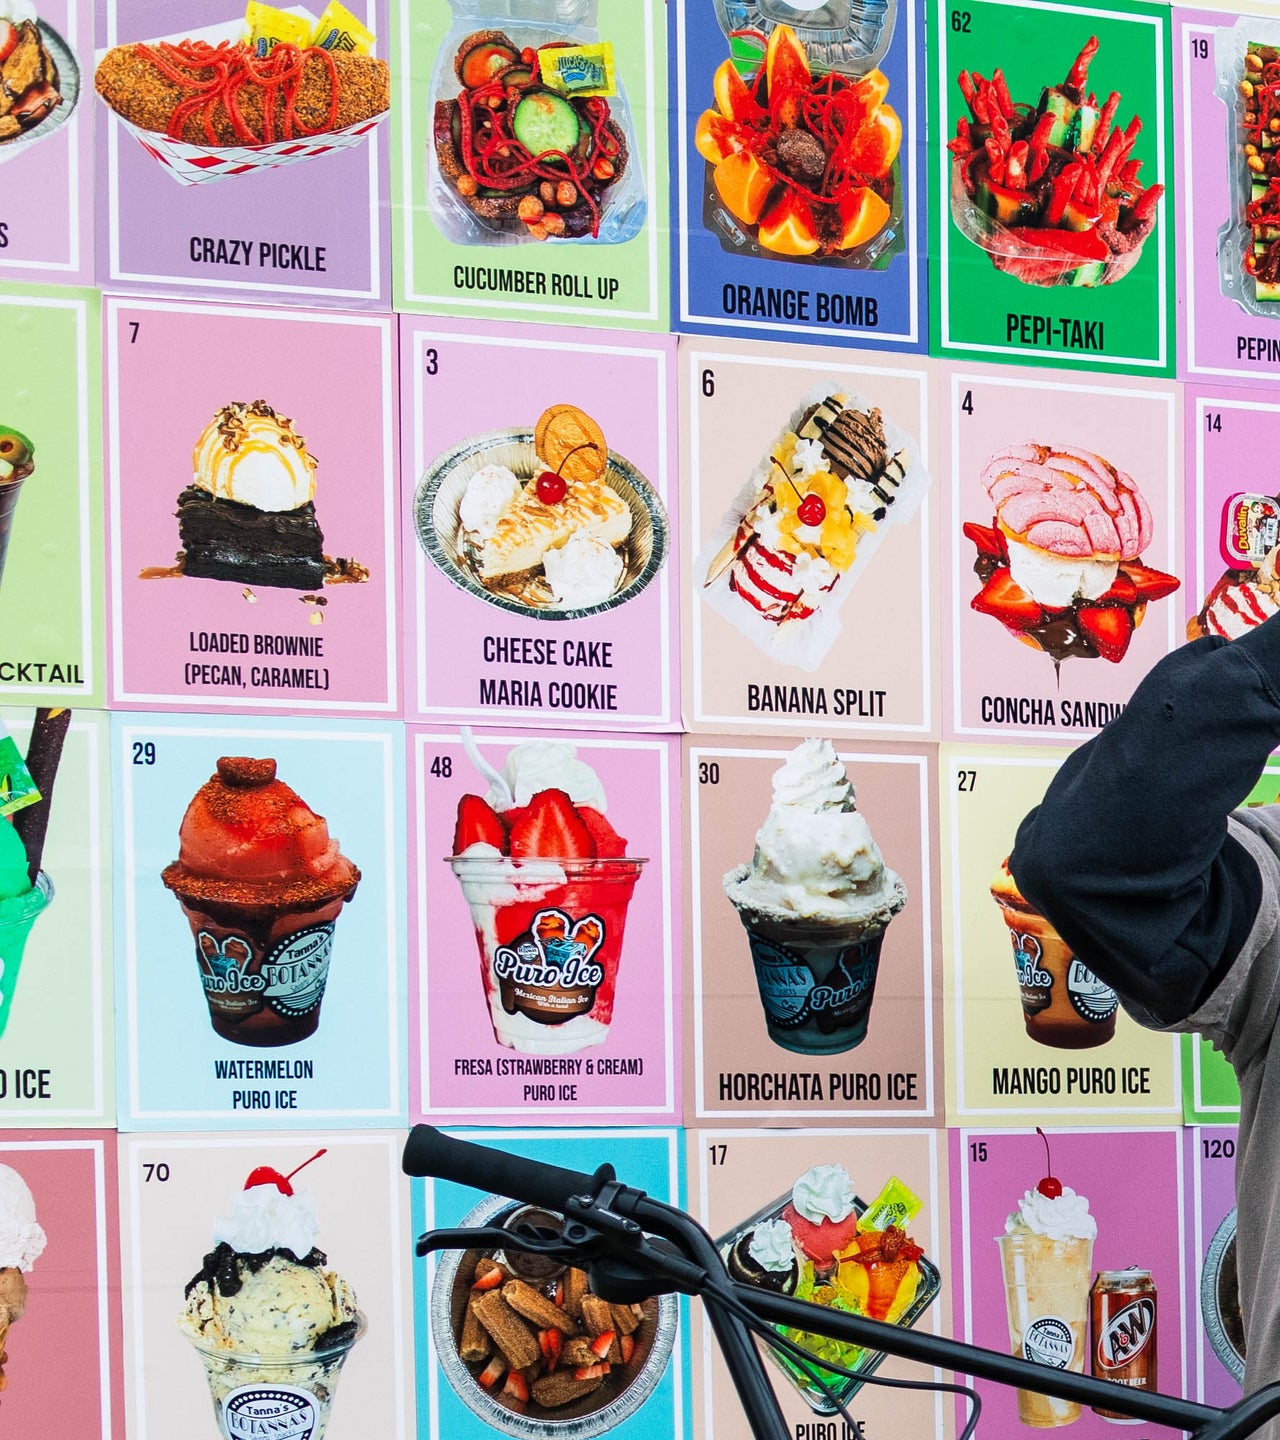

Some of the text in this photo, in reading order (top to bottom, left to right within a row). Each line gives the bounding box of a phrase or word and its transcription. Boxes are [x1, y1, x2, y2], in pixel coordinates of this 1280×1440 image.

[952, 11, 972, 33] 62
[1191, 38, 1209, 59] 19
[189, 236, 327, 272] CRAZY PICKLE
[453, 265, 619, 301] CUCUMBER ROLL UP
[722, 283, 879, 327] ORANGE BOMB
[129, 322, 139, 344] 7
[1006, 313, 1104, 350] PEPI-TAKI
[426, 349, 439, 375] 3
[702, 370, 715, 397] 6
[961, 391, 973, 415] 4
[1206, 413, 1222, 433] 14
[190, 632, 324, 658] LOADED BROWNIE
[483, 636, 613, 668] CHEESE CAKE
[0, 662, 84, 684] CKTAIL
[184, 665, 330, 690] (PECAN, CARAMEL)
[479, 679, 617, 711] MARIA COOKIE
[748, 685, 886, 718] BANANA SPLIT
[981, 696, 1126, 728] CONCHA SANDW
[133, 743, 156, 765] 29
[431, 757, 452, 778] 48
[699, 763, 719, 784] 30
[957, 771, 977, 792] 27
[287, 935, 324, 959] Tanna's
[498, 951, 601, 986] Puro Ice
[204, 976, 226, 992] uro
[215, 1060, 313, 1080] WATERMELON
[455, 1058, 643, 1077] FRESA (STRAWBERRY & CREAM)
[15, 1069, 51, 1099] ICE
[524, 1085, 577, 1101] PURO ICE
[719, 1073, 917, 1101] HORCHATA PURO ICE
[992, 1068, 1150, 1095] MANGO PURO ICE
[233, 1090, 298, 1109] PURO ICE
[709, 1145, 727, 1166] 17
[970, 1143, 988, 1163] 15
[1203, 1139, 1235, 1159] 120
[143, 1163, 170, 1182] 70
[1109, 1302, 1148, 1367] A&W
[246, 1403, 289, 1416] Tanna's
[231, 1409, 307, 1435] BOTANNAS
